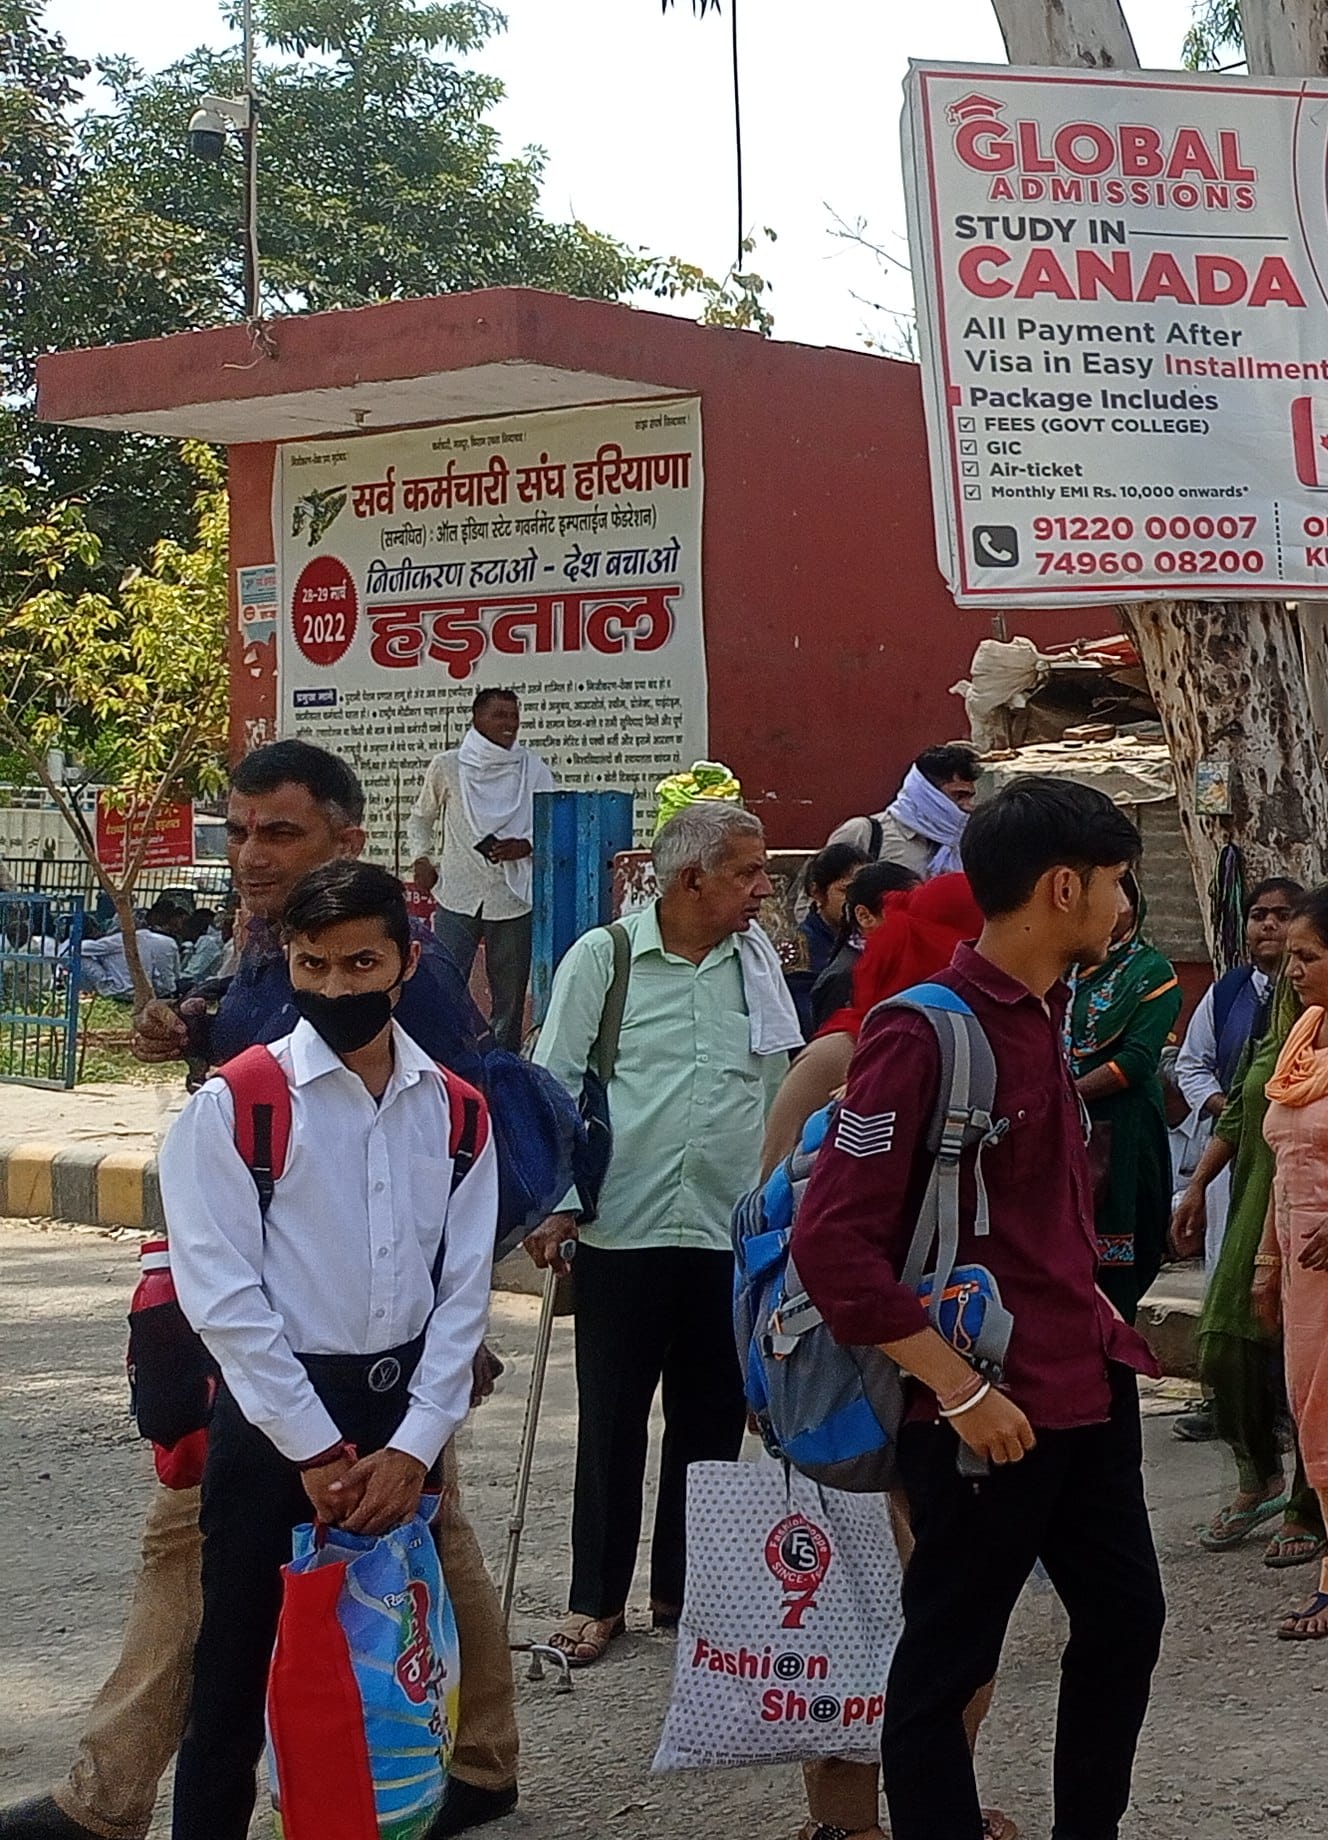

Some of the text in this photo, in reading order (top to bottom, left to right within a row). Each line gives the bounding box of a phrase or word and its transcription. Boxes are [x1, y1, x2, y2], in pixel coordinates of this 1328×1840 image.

[954, 118, 1257, 183] GLOBAL
[990, 176, 1255, 210] ADMISSIONS
[955, 215, 1127, 245] STUDY IN
[958, 245, 1307, 308] CANADA
[963, 317, 1242, 347] All Payment After
[965, 349, 1032, 373] Visa
[1044, 351, 1072, 374] in
[1083, 352, 1154, 379] Easy
[969, 388, 1219, 412] Package Includes
[984, 417, 1210, 435] FEES (GOVT COLLEGE)
[987, 441, 1022, 456] GIC
[352, 445, 692, 520] सर्व कर्मचारी संघ हरियाणा
[989, 462, 1083, 478] Air-ticket
[991, 486, 1055, 500] Monthly
[1060, 486, 1089, 499] EMI
[1093, 487, 1117, 499] Rs.
[1120, 487, 1175, 500] 10,000
[436, 520, 458, 544] ऑल
[461, 518, 489, 546] इंडिया
[1032, 515, 1257, 541] 91220 00007
[366, 558, 463, 594] निजीकरण
[470, 547, 538, 590] हटाओ
[563, 543, 598, 580] देश
[606, 537, 681, 575] बचाओ
[1035, 550, 1264, 575] 74960 08200
[303, 615, 346, 643] 2022
[366, 586, 681, 680] हड़ताल
[769, 1518, 802, 1549] Fashio
[790, 1532, 817, 1568] FS
[691, 1637, 830, 1681] Fashion
[760, 1688, 885, 1728] Shopp
